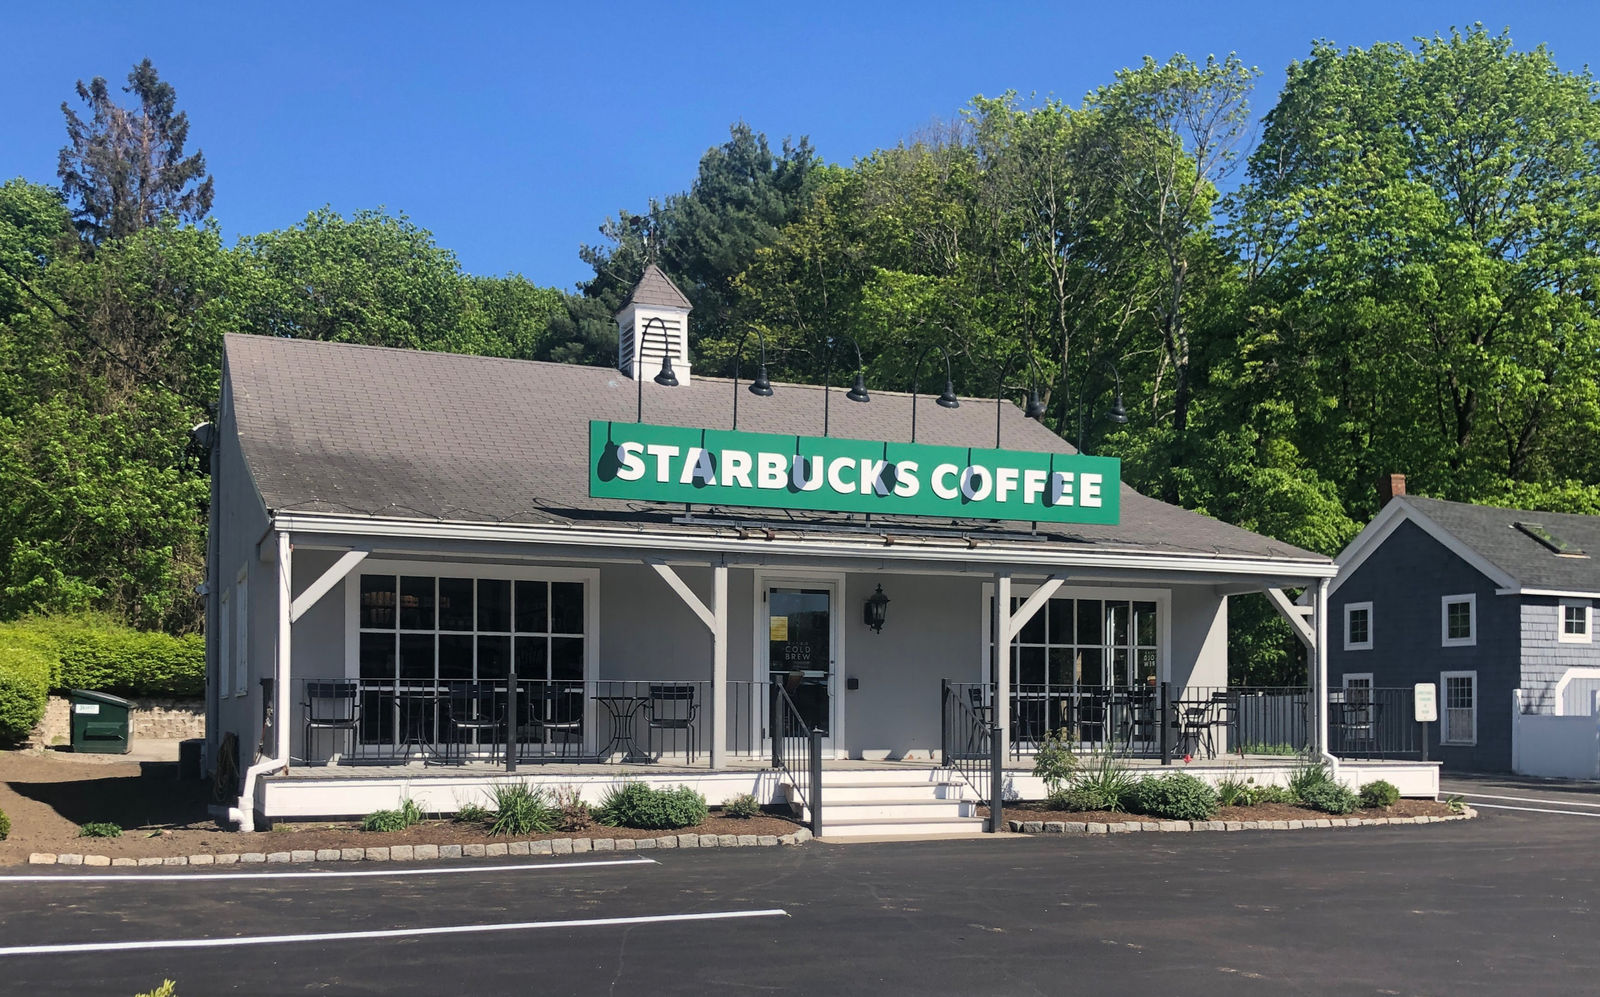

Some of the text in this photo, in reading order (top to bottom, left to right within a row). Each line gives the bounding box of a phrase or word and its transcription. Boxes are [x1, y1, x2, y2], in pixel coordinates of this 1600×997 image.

[616, 441, 1103, 508] STARBUCKS COFFEE
[785, 645, 811, 653] COLD
